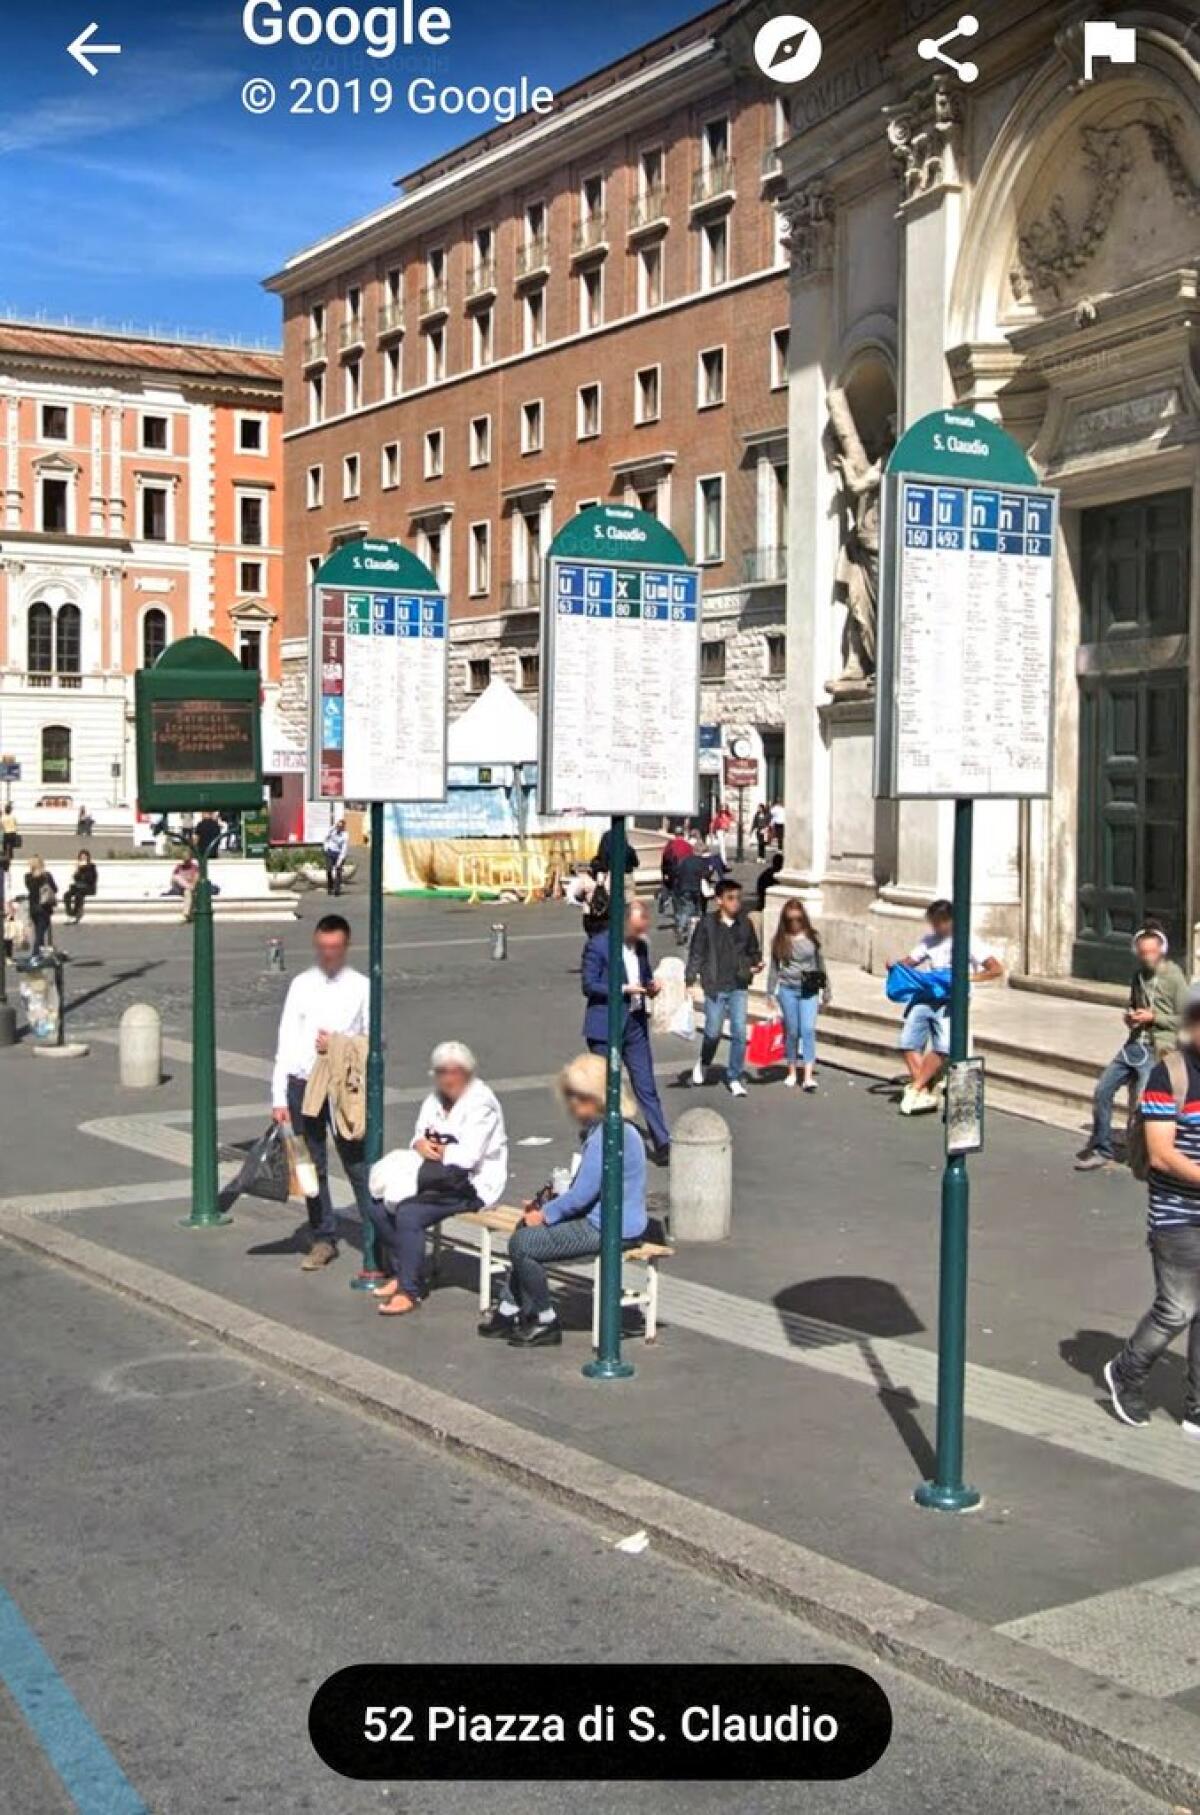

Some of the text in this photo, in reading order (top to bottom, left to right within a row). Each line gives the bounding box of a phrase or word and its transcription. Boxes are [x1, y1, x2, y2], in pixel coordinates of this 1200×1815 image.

[933, 434, 990, 456] S. Claudio
[607, 525, 647, 541] Claudio
[1028, 538, 1040, 554] 12
[365, 558, 400, 571] Claudio
